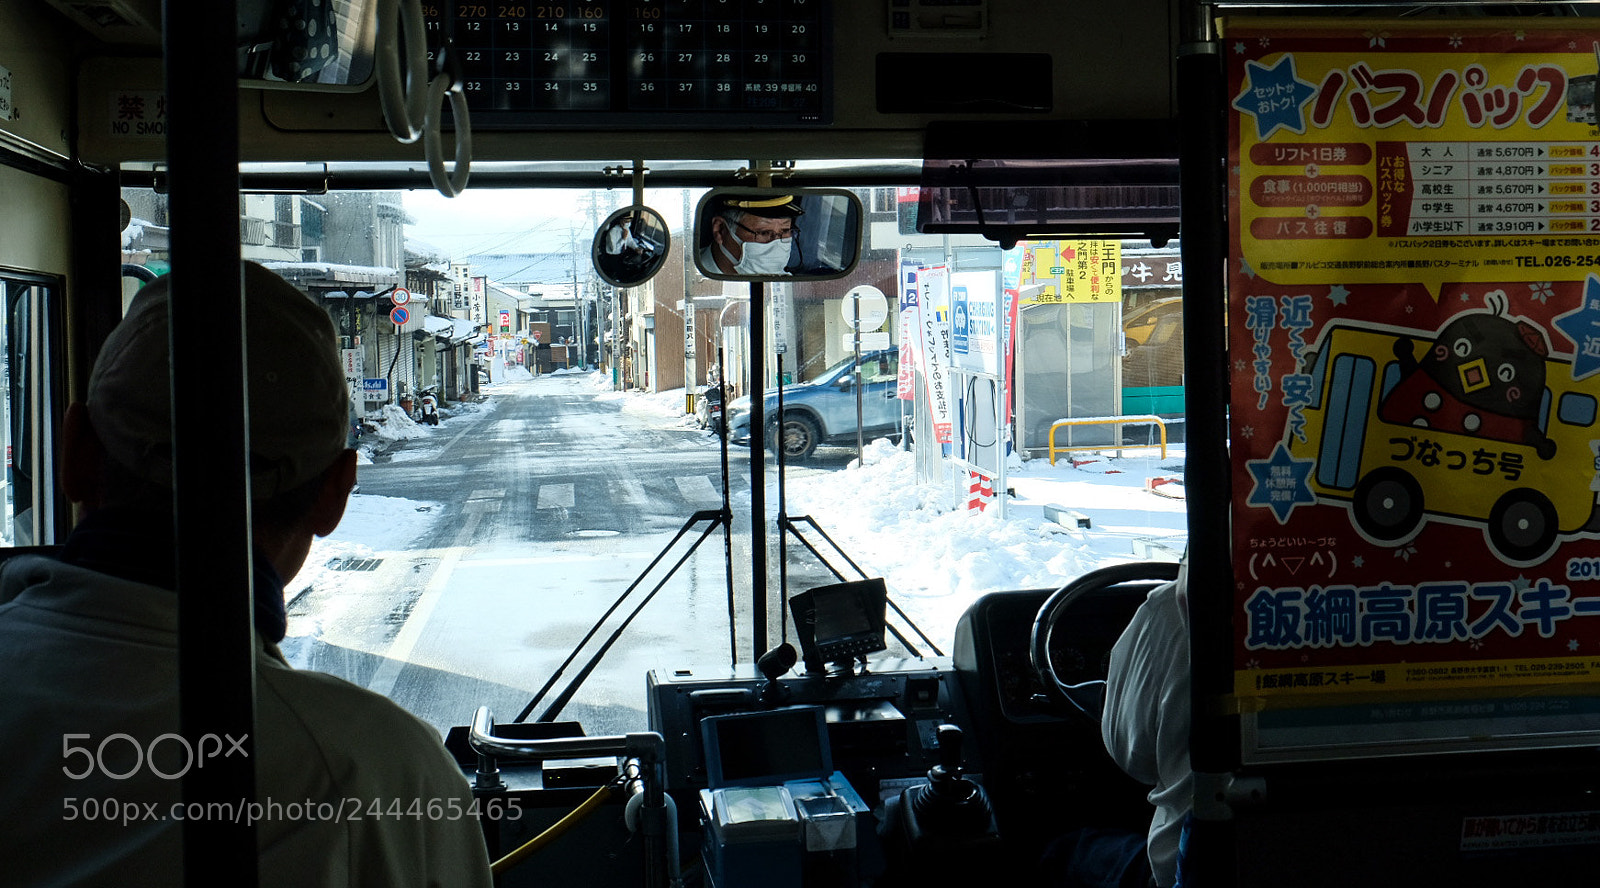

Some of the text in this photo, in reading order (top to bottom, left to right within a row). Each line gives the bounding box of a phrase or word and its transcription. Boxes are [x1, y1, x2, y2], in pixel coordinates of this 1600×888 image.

[459, 5, 487, 18] 270
[498, 5, 526, 18] 240
[536, 6, 565, 18] 210
[577, 6, 604, 19] 160
[634, 6, 661, 19] 160
[466, 22, 481, 32] 12
[505, 22, 520, 32] 13
[544, 23, 559, 32] 14
[583, 23, 597, 32] 15
[640, 23, 655, 33] 16
[679, 24, 693, 33] 17
[716, 24, 731, 33] 18
[754, 24, 769, 33] 19
[791, 24, 806, 34] 20
[466, 52, 481, 62] 22
[505, 52, 520, 62] 23
[544, 52, 559, 62] 24
[582, 53, 597, 62] 25
[640, 53, 655, 63] 26
[678, 53, 693, 63] 27
[716, 53, 731, 63] 28
[754, 54, 769, 63] 29
[791, 54, 806, 63] 30
[466, 82, 481, 92] 32
[505, 82, 521, 92] 33
[544, 82, 560, 92] 34
[582, 82, 598, 92] 35
[640, 82, 655, 92] 36
[679, 82, 693, 92] 37
[716, 83, 731, 92] 38
[764, 83, 778, 92] 39
[805, 83, 818, 92] 40
[1254, 82, 1295, 99] セットが
[1312, 64, 1567, 128] バスパック
[1257, 96, 1296, 114] おトク!
[112, 121, 130, 134] NO
[1274, 147, 1347, 161] リフト1日券
[1393, 155, 1405, 193] お得な
[1421, 165, 1454, 176] シニア
[1380, 156, 1392, 228] バスパック券
[1421, 184, 1455, 195] 高校生
[1421, 203, 1455, 214] 中学生
[1412, 220, 1464, 232] 小学生以下
[1077, 240, 1088, 280] 之門第2
[395, 292, 407, 302] 30
[1245, 294, 1278, 411] 滑りやすい!
[1388, 436, 1525, 483] づなっち号
[1270, 465, 1292, 477] 無料
[1265, 477, 1297, 489] 休憩所
[1246, 580, 1600, 648] 飯綱高原スキー
